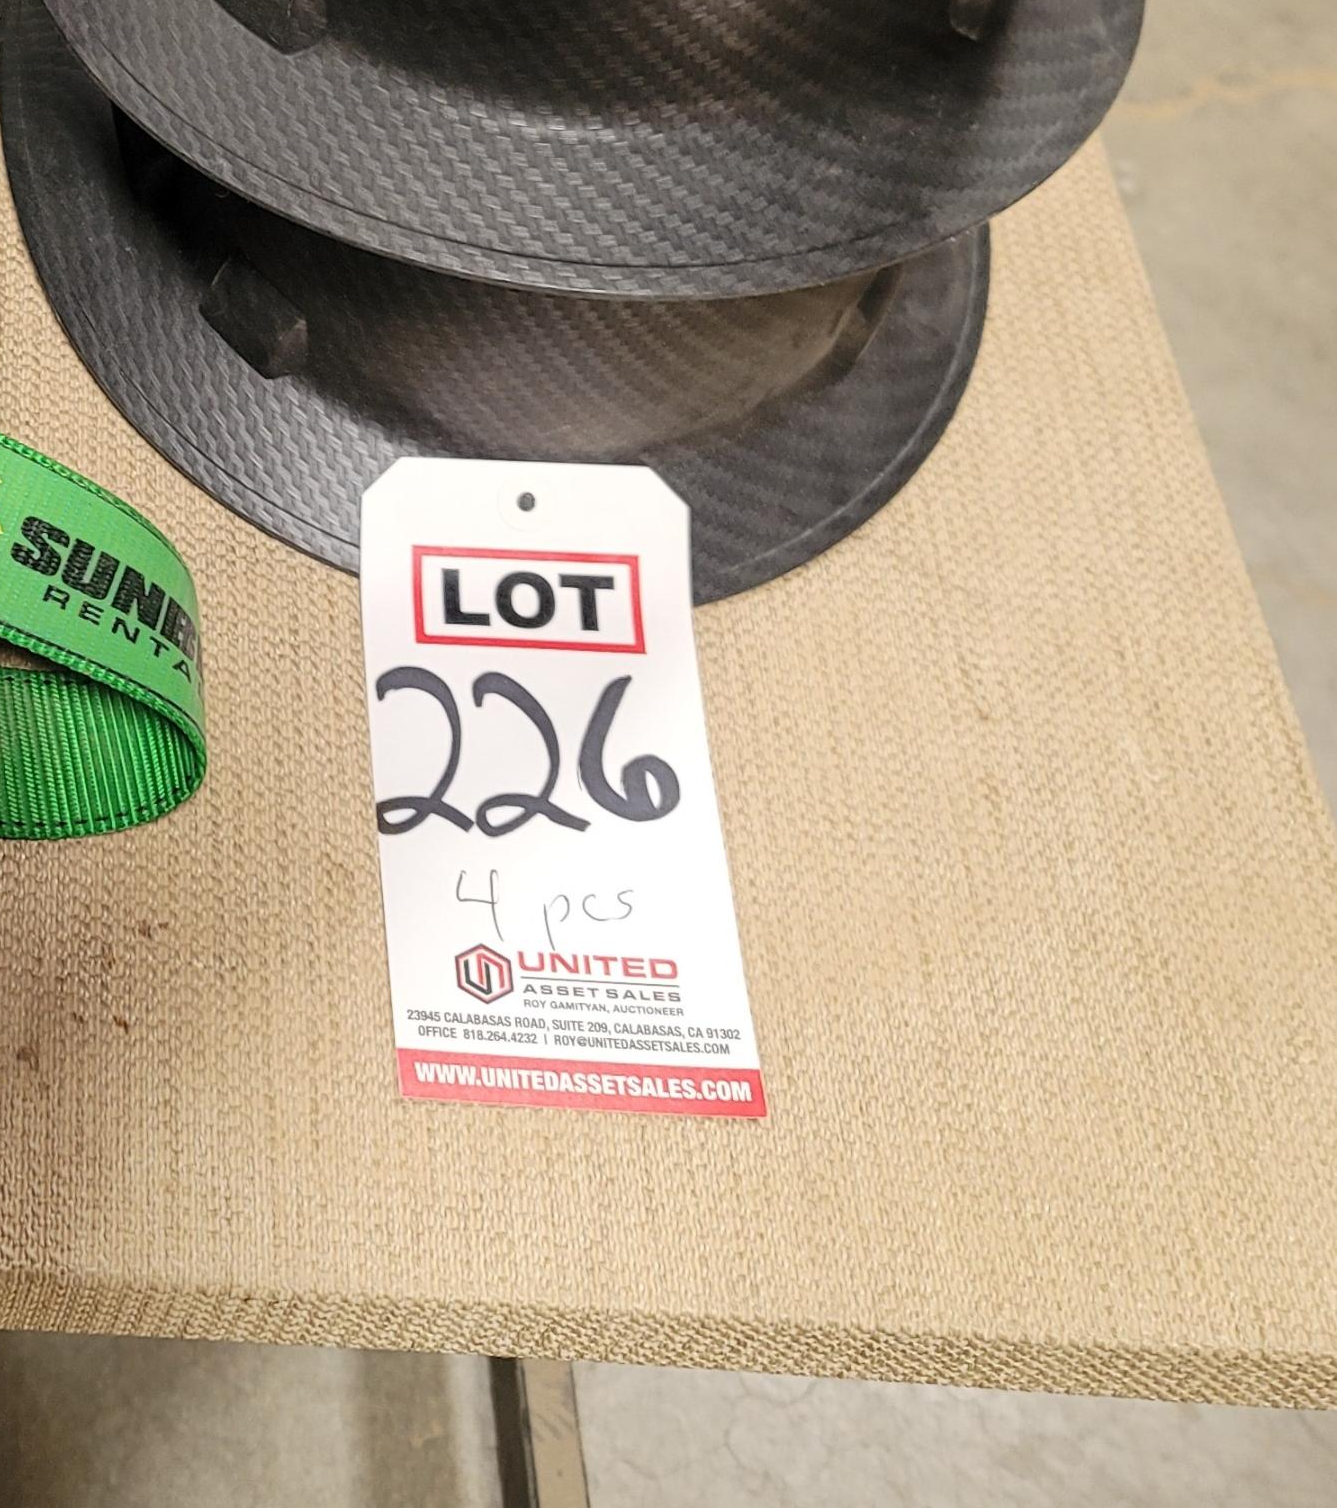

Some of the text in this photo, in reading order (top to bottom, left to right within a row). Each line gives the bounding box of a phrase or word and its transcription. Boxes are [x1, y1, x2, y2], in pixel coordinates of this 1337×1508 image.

[11, 515, 200, 662] SUNB
[441, 567, 615, 632] LOT
[42, 584, 195, 683] RENTA
[375, 665, 681, 838] 226
[455, 869, 634, 951] 4 pcs
[517, 950, 679, 980] UNITED
[522, 983, 682, 1003] ASSET SALES
[523, 999, 685, 1017] ROY GAMITYAN, AUCTIONEER
[407, 1009, 742, 1041] 23945 CALABASAS ROAD, SUITE 209, CALABASAS, CA 91302
[418, 1025, 458, 1039] OFFICE
[463, 1028, 538, 1045] 818.264.4232
[554, 1035, 731, 1055] ROY@UNITEDASSETSALES.COM
[414, 1061, 754, 1103] WWW.UNITEDASSETSALES.COM
